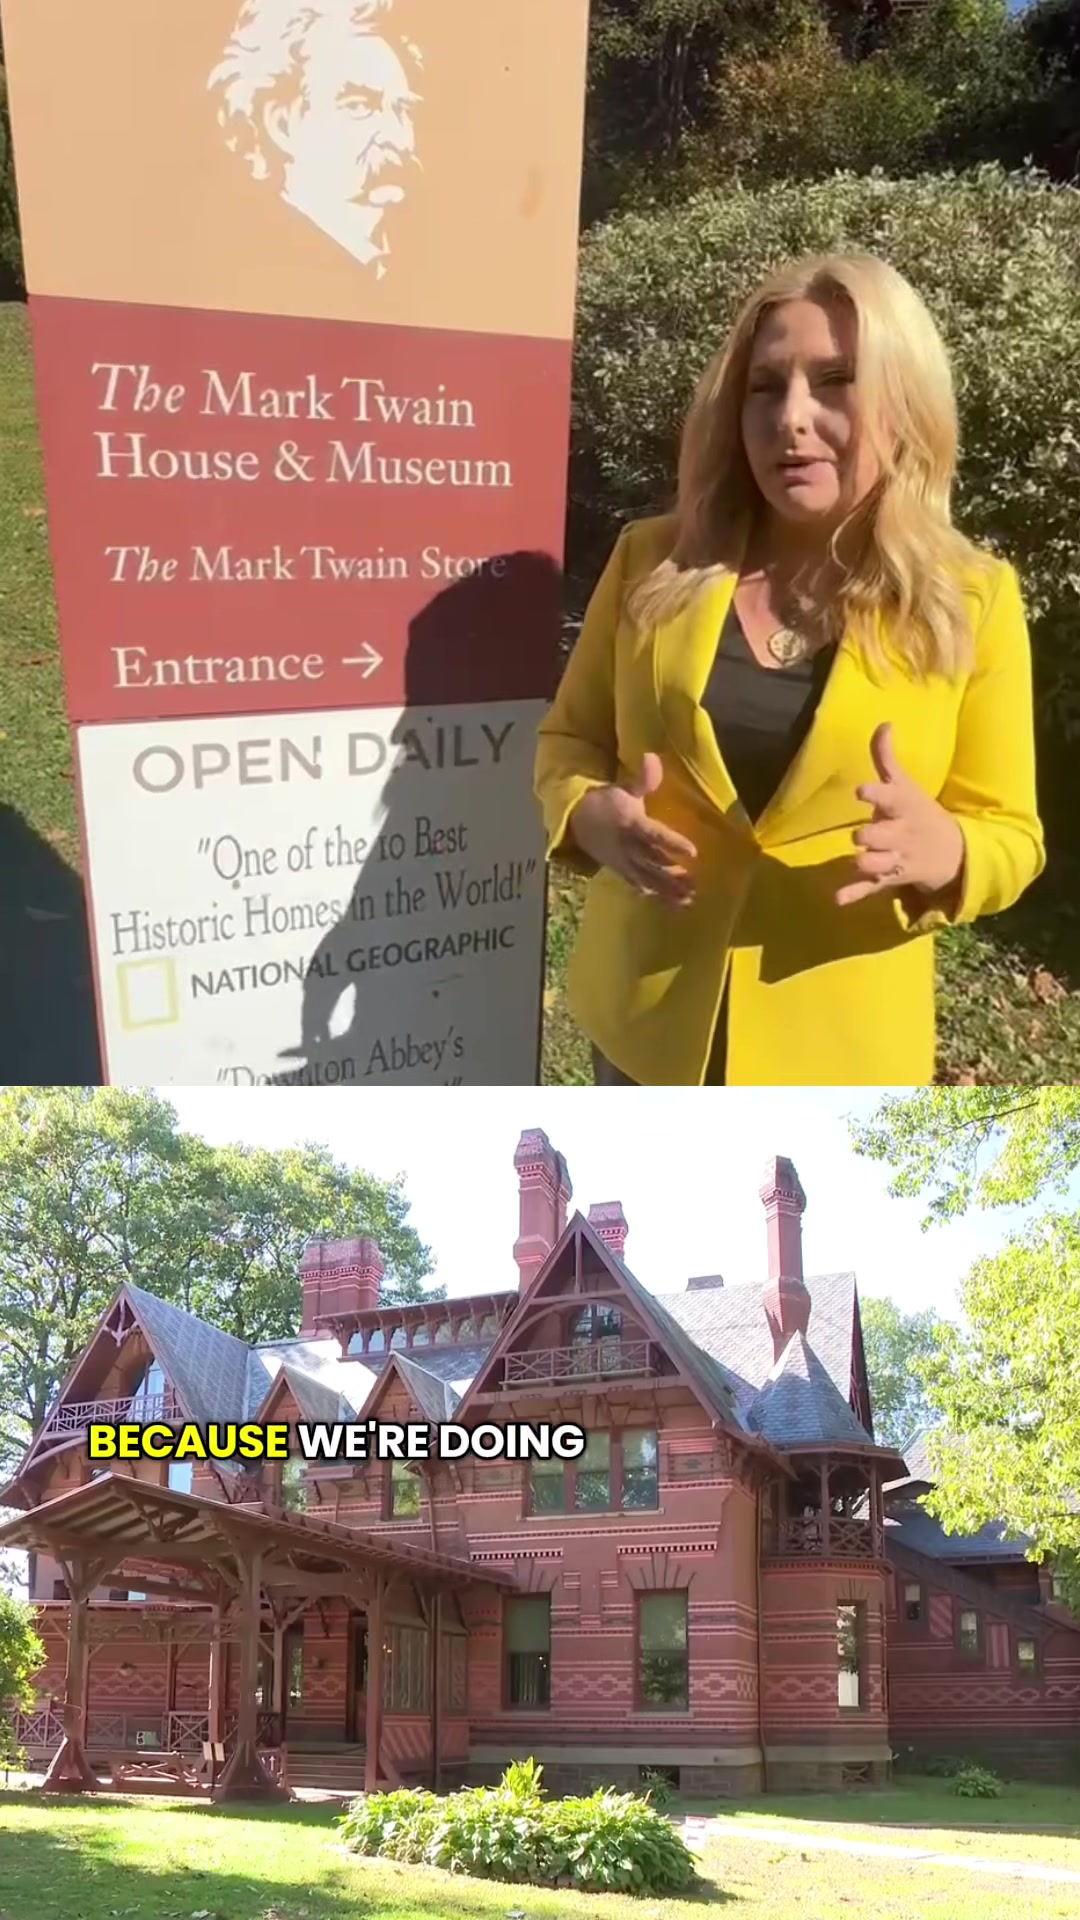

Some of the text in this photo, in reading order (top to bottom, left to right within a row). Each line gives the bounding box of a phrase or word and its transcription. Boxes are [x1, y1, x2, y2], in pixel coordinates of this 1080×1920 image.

[92, 362, 475, 428] The Mark Twain
[94, 432, 513, 488] House & Museum
[105, 546, 507, 582] The Mark Twain Store
[111, 645, 324, 688] Entrance
[133, 721, 515, 793] OPEN DAILY
[288, 826, 319, 871] of
[325, 824, 367, 866] the
[414, 816, 468, 856] Best
[111, 903, 234, 955] Historic
[243, 893, 342, 938] Homes
[351, 884, 375, 921] in
[385, 877, 425, 915] the
[191, 925, 516, 999] NATIONAL GEOGRAPHIC
[369, 1027, 465, 1077] Abbey's
